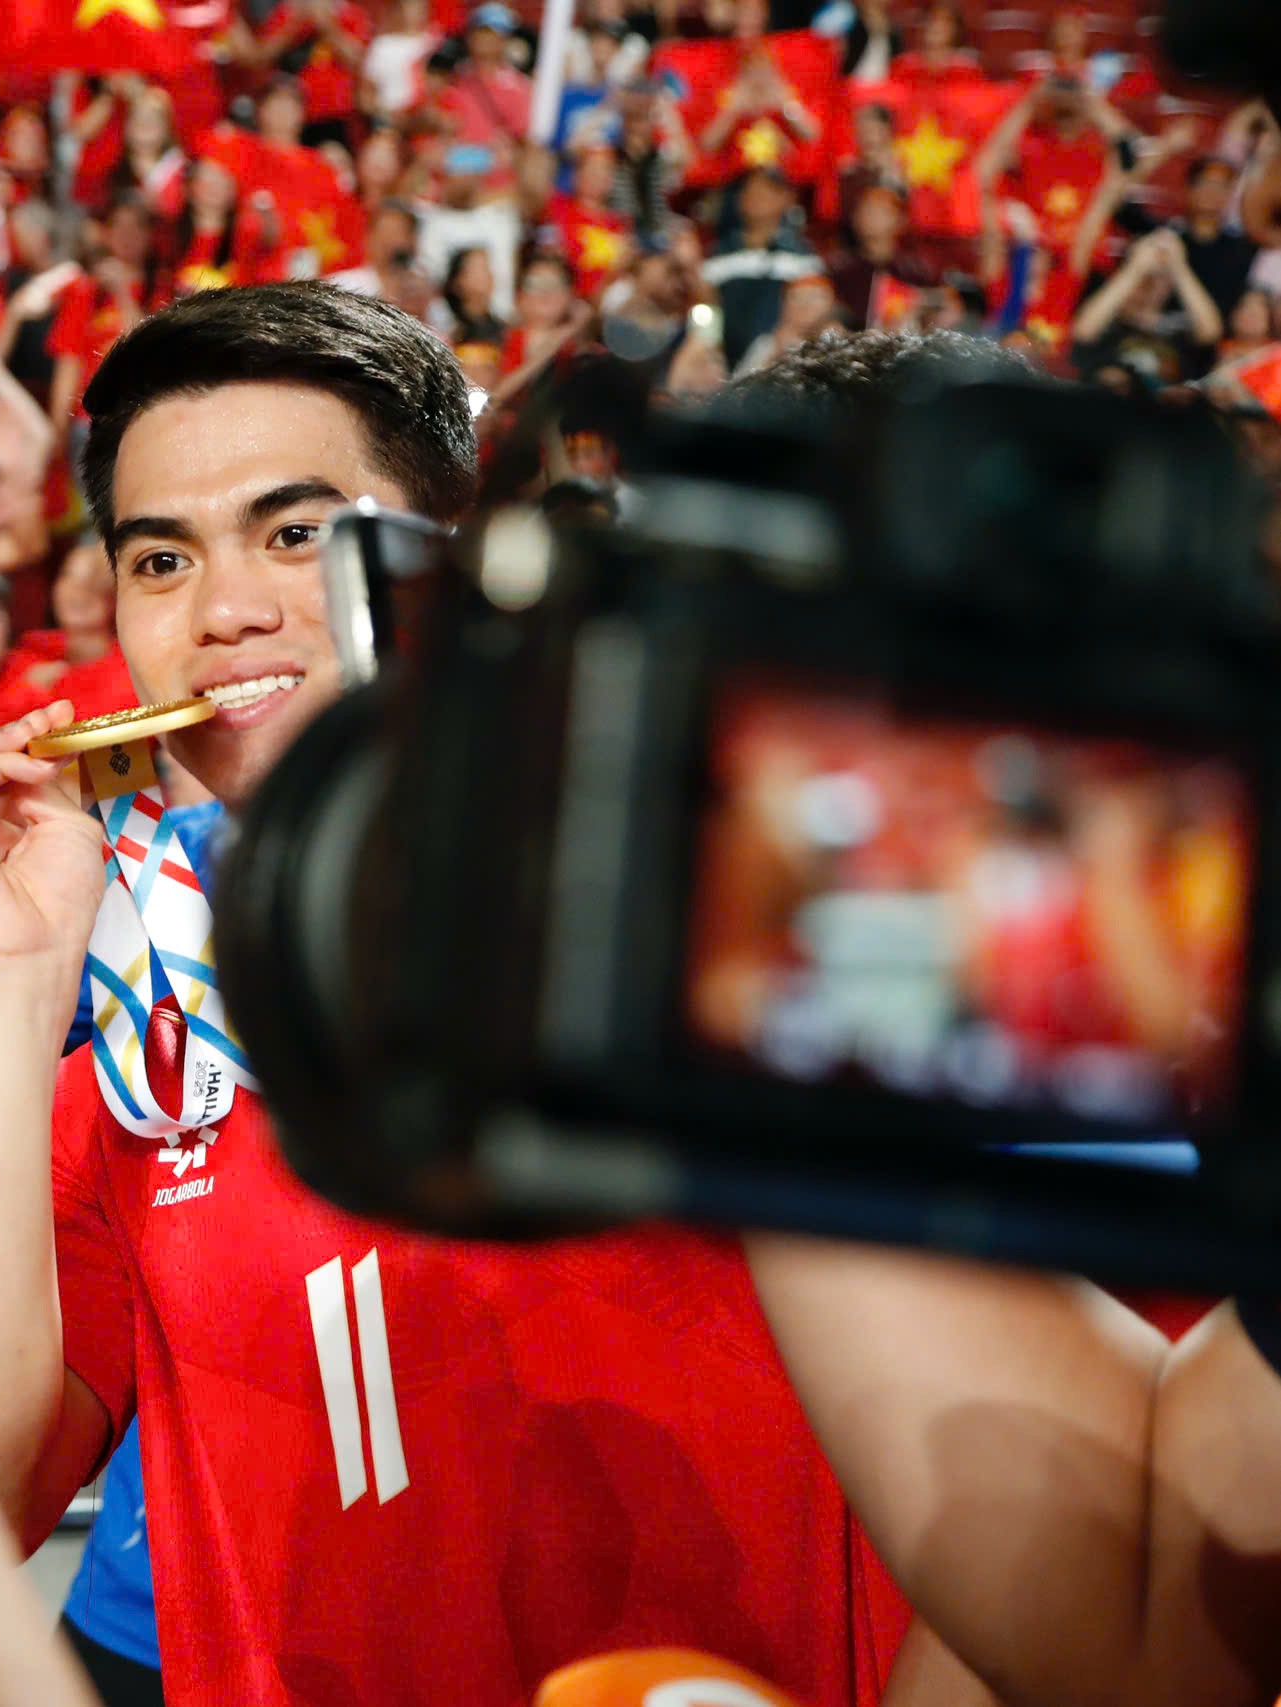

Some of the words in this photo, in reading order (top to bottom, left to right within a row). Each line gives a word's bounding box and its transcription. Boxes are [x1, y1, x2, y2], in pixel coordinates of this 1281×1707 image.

[193, 1060, 208, 1098] 2025
[151, 1175, 215, 1208] JOGARBOLA
[304, 1245, 410, 1512] 11
